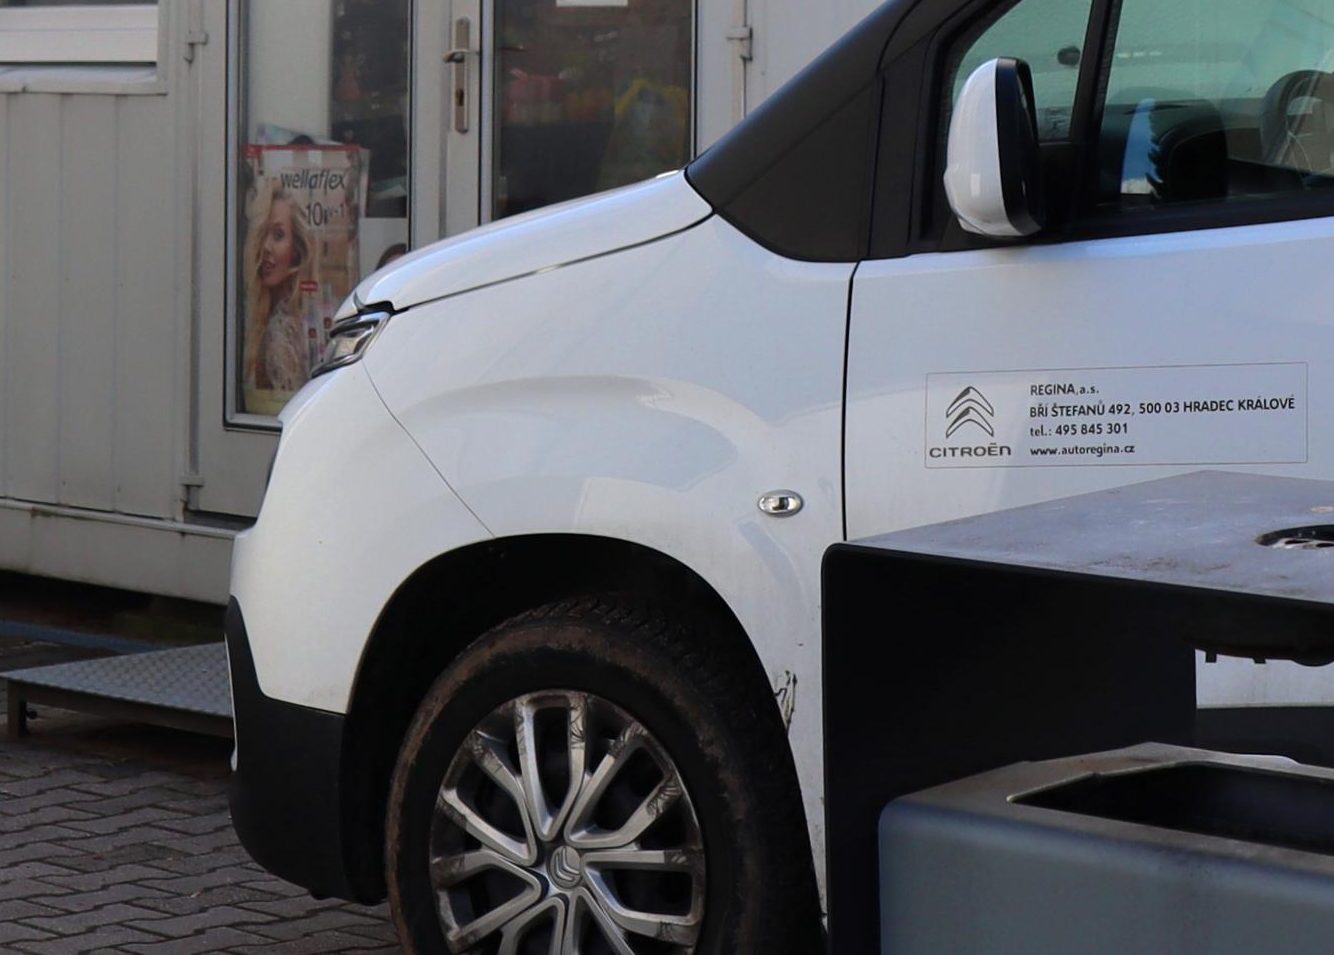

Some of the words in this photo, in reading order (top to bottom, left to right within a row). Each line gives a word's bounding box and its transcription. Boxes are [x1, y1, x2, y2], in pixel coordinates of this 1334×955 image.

[281, 168, 346, 192] wellaflex
[1029, 402, 1049, 418] BŘÍ
[1051, 400, 1106, 417] ŠTEFANŮ
[1108, 402, 1135, 416] 492,
[1139, 402, 1162, 414] 500
[1164, 401, 1180, 414] 03
[1183, 399, 1234, 412] HRADEC
[1237, 394, 1295, 410] KRÁLOVÉ
[1030, 425, 1053, 437] tel.:
[1055, 423, 1077, 436] 495
[1080, 422, 1103, 435] 845
[1106, 422, 1128, 434] 301
[1030, 443, 1135, 457] www.autoregina.cz
